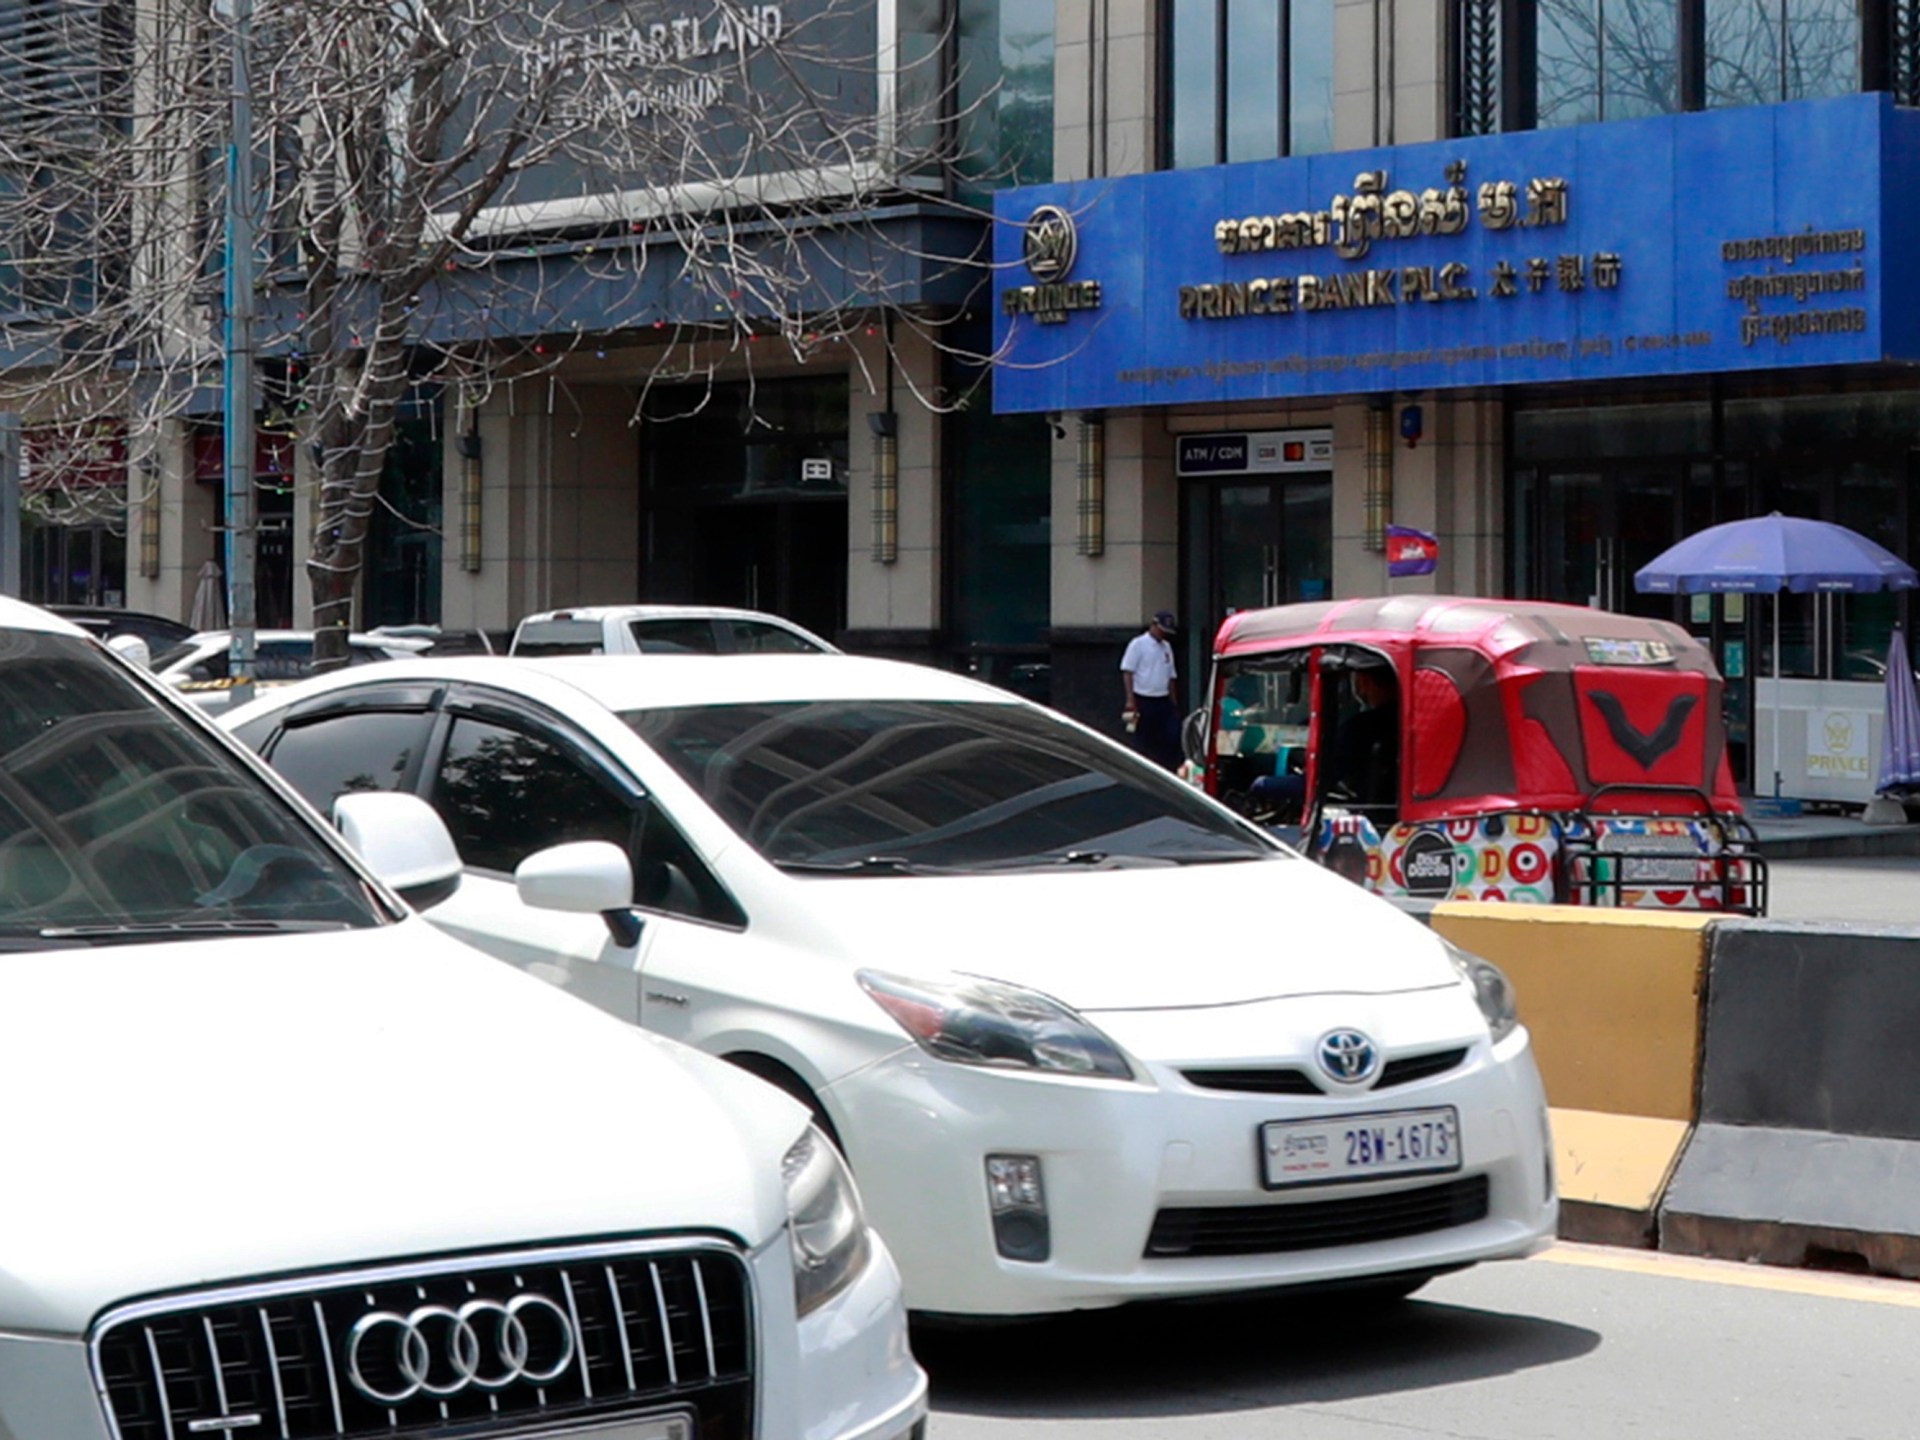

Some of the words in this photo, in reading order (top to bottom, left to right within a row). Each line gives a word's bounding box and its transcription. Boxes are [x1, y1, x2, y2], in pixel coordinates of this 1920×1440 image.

[583, 5, 782, 72] HEARTLAND
[1003, 279, 1101, 316] PRINCE
[1179, 277, 1294, 321] PRINCE
[1297, 269, 1397, 312] BANK
[1401, 261, 1478, 303] PLC.
[1184, 447, 1208, 461] ATM
[1218, 445, 1243, 460] CDM
[1808, 754, 1869, 772] PRINCE
[1344, 1122, 1449, 1166] 2BW-1673
